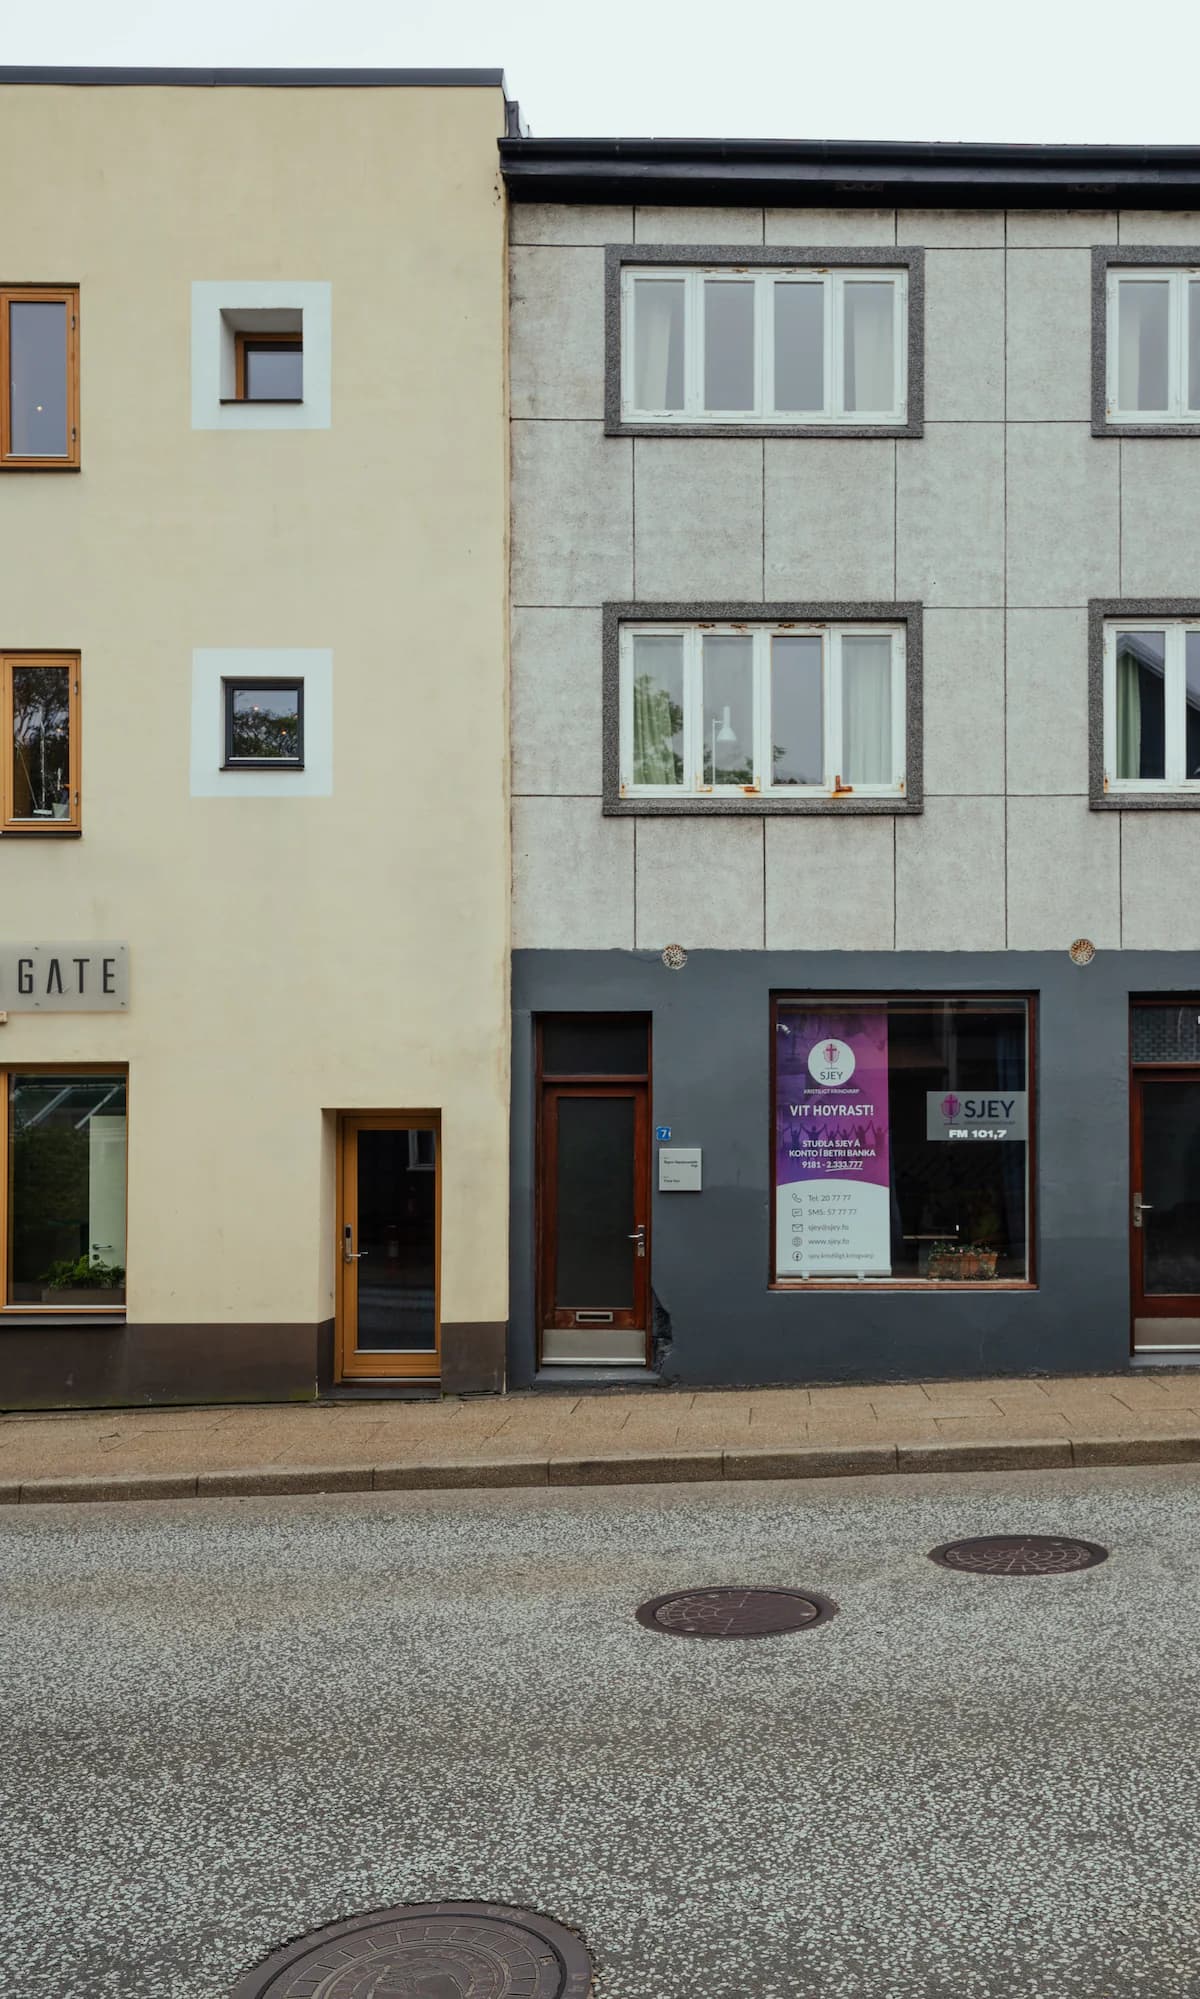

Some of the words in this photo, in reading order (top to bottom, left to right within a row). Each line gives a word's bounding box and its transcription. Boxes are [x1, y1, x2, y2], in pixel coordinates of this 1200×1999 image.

[18, 958, 116, 994] GATE
[819, 1071, 844, 1080] SJEY
[789, 1104, 810, 1116] VIT
[813, 1104, 874, 1116] HOYRAST!
[964, 1100, 1015, 1118] SJEY
[660, 1129, 668, 1138] 7
[948, 1129, 969, 1138] FM
[971, 1129, 1007, 1140] 101,7
[789, 1149, 819, 1157] KONTO
[823, 1149, 846, 1157] BETRI
[847, 1149, 877, 1157] BANKA
[802, 1161, 821, 1169] 9181
[821, 1194, 830, 1202] 20
